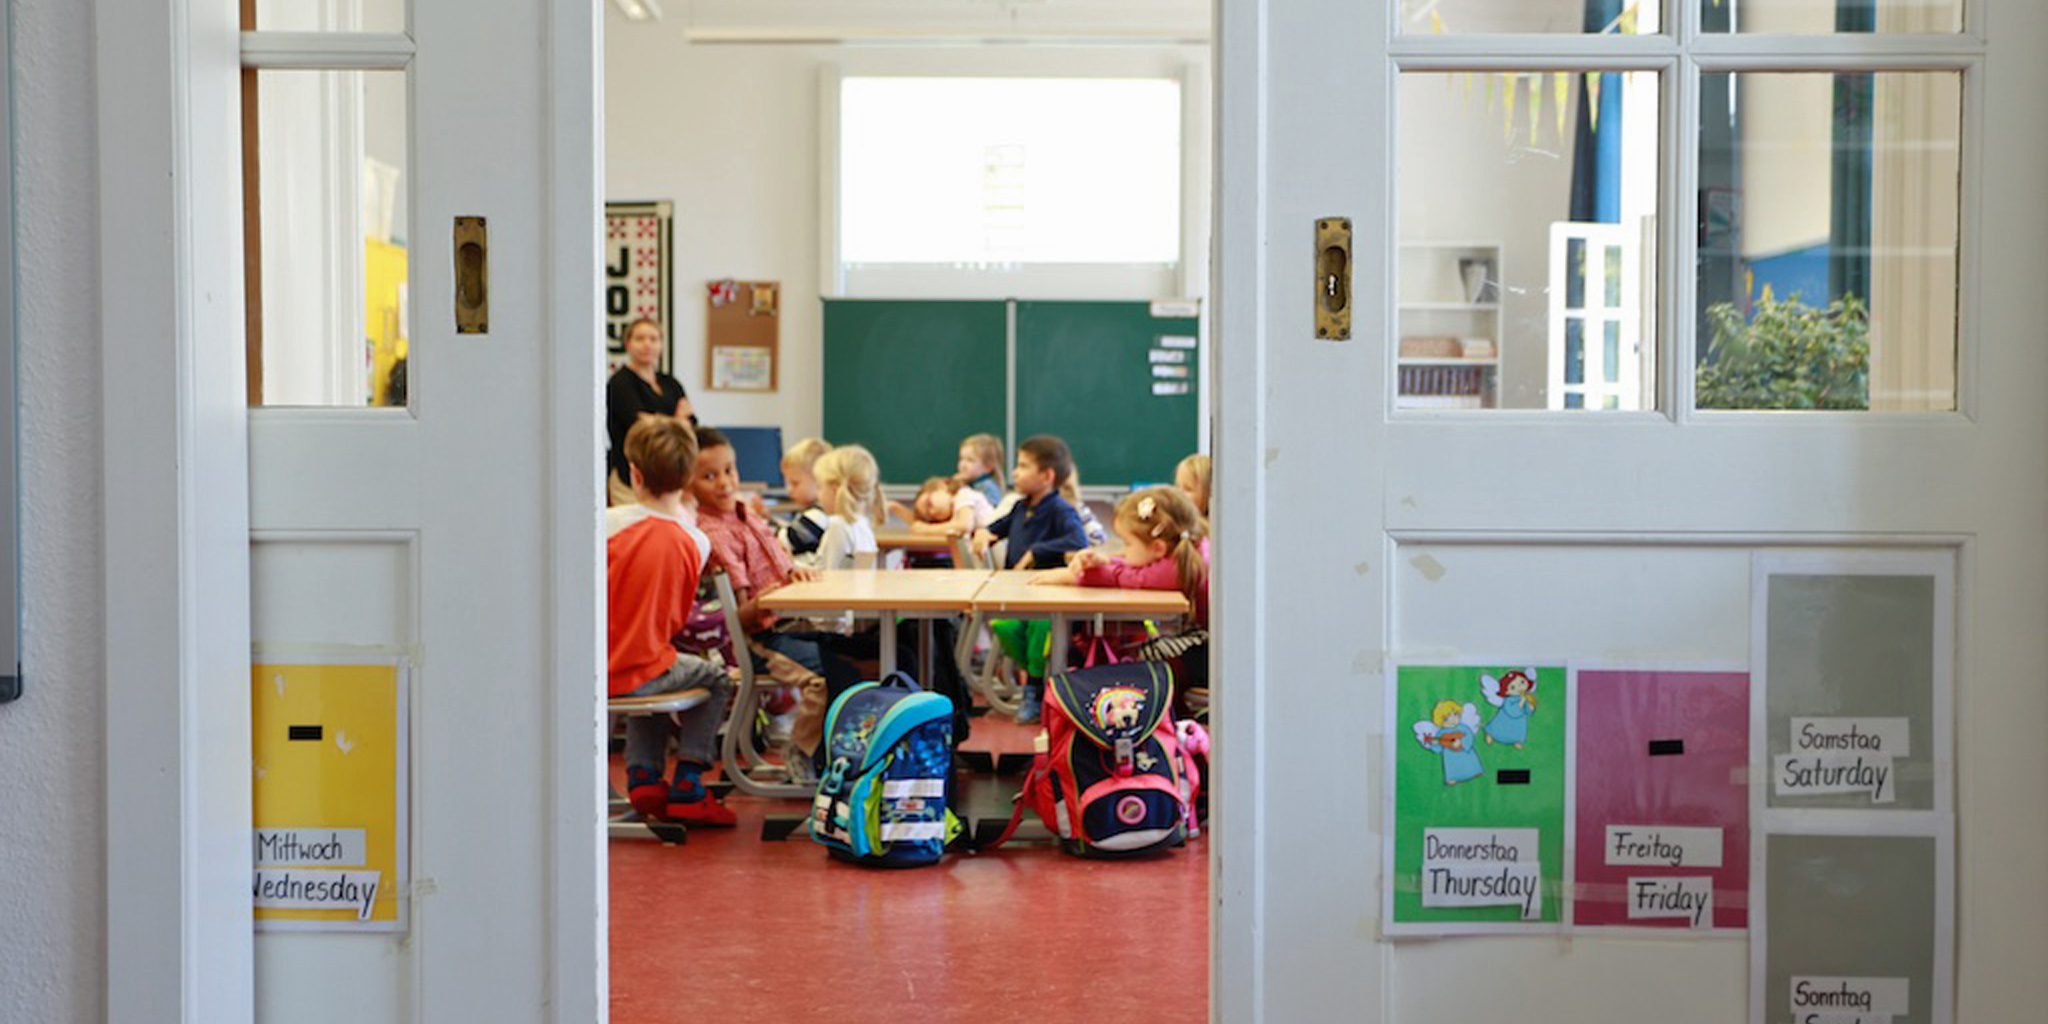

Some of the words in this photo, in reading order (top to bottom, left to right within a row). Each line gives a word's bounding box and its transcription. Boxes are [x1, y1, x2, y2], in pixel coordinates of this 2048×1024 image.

[1799, 723, 1881, 751] Samstag
[1783, 757, 1888, 799] Saturday
[258, 832, 343, 861] Mittwoch
[1426, 835, 1518, 862] Donnerstag
[1614, 831, 1683, 867] Freitag
[1429, 867, 1537, 918] Thursday
[1636, 881, 1708, 926] Friday
[1794, 980, 1871, 1012] Sonntag
